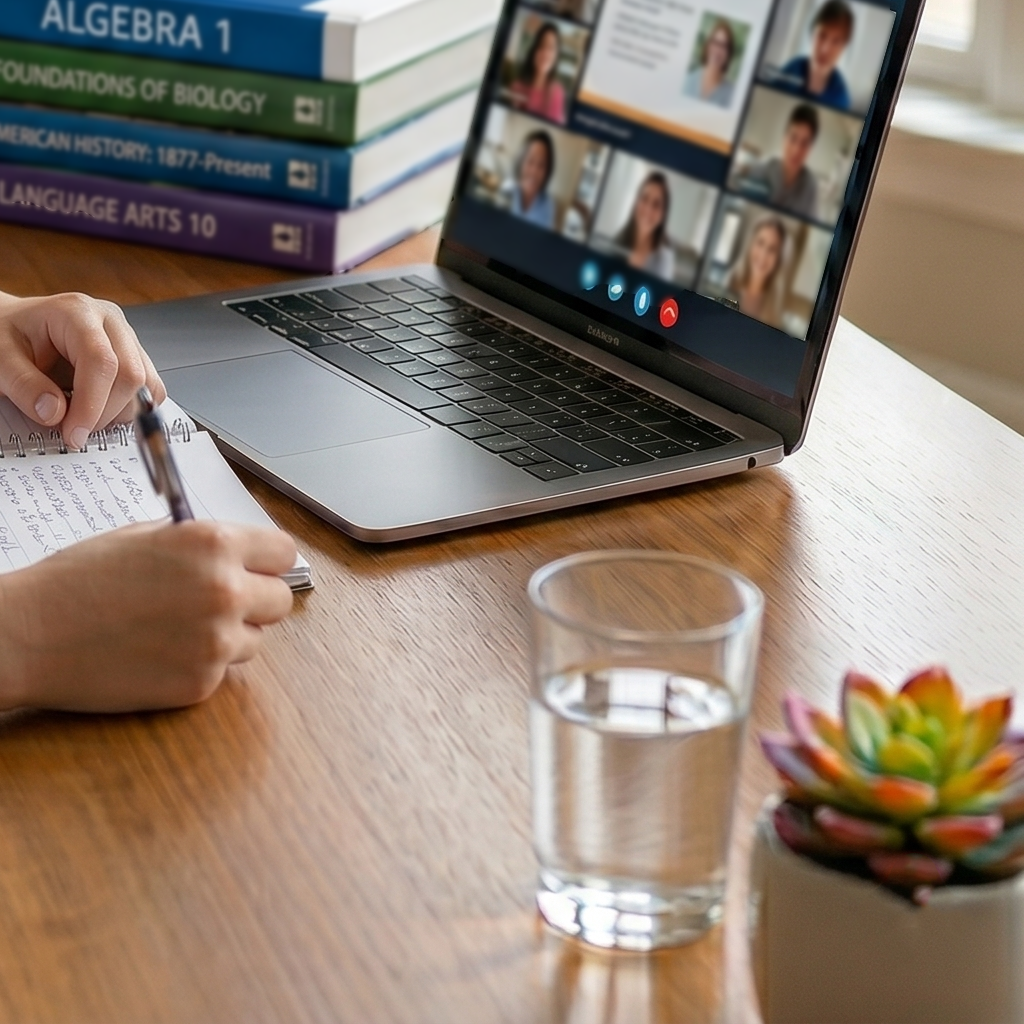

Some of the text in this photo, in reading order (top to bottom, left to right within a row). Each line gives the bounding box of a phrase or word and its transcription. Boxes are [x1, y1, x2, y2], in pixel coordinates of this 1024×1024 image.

[216, 18, 230, 53] 1
[140, 78, 169, 103] OF
[173, 82, 266, 115] BIOLOGY
[75, 133, 153, 164] HISTORY:
[157, 146, 272, 181] 1877-Present
[124, 201, 182, 234] ARTS
[189, 213, 217, 238] 10
